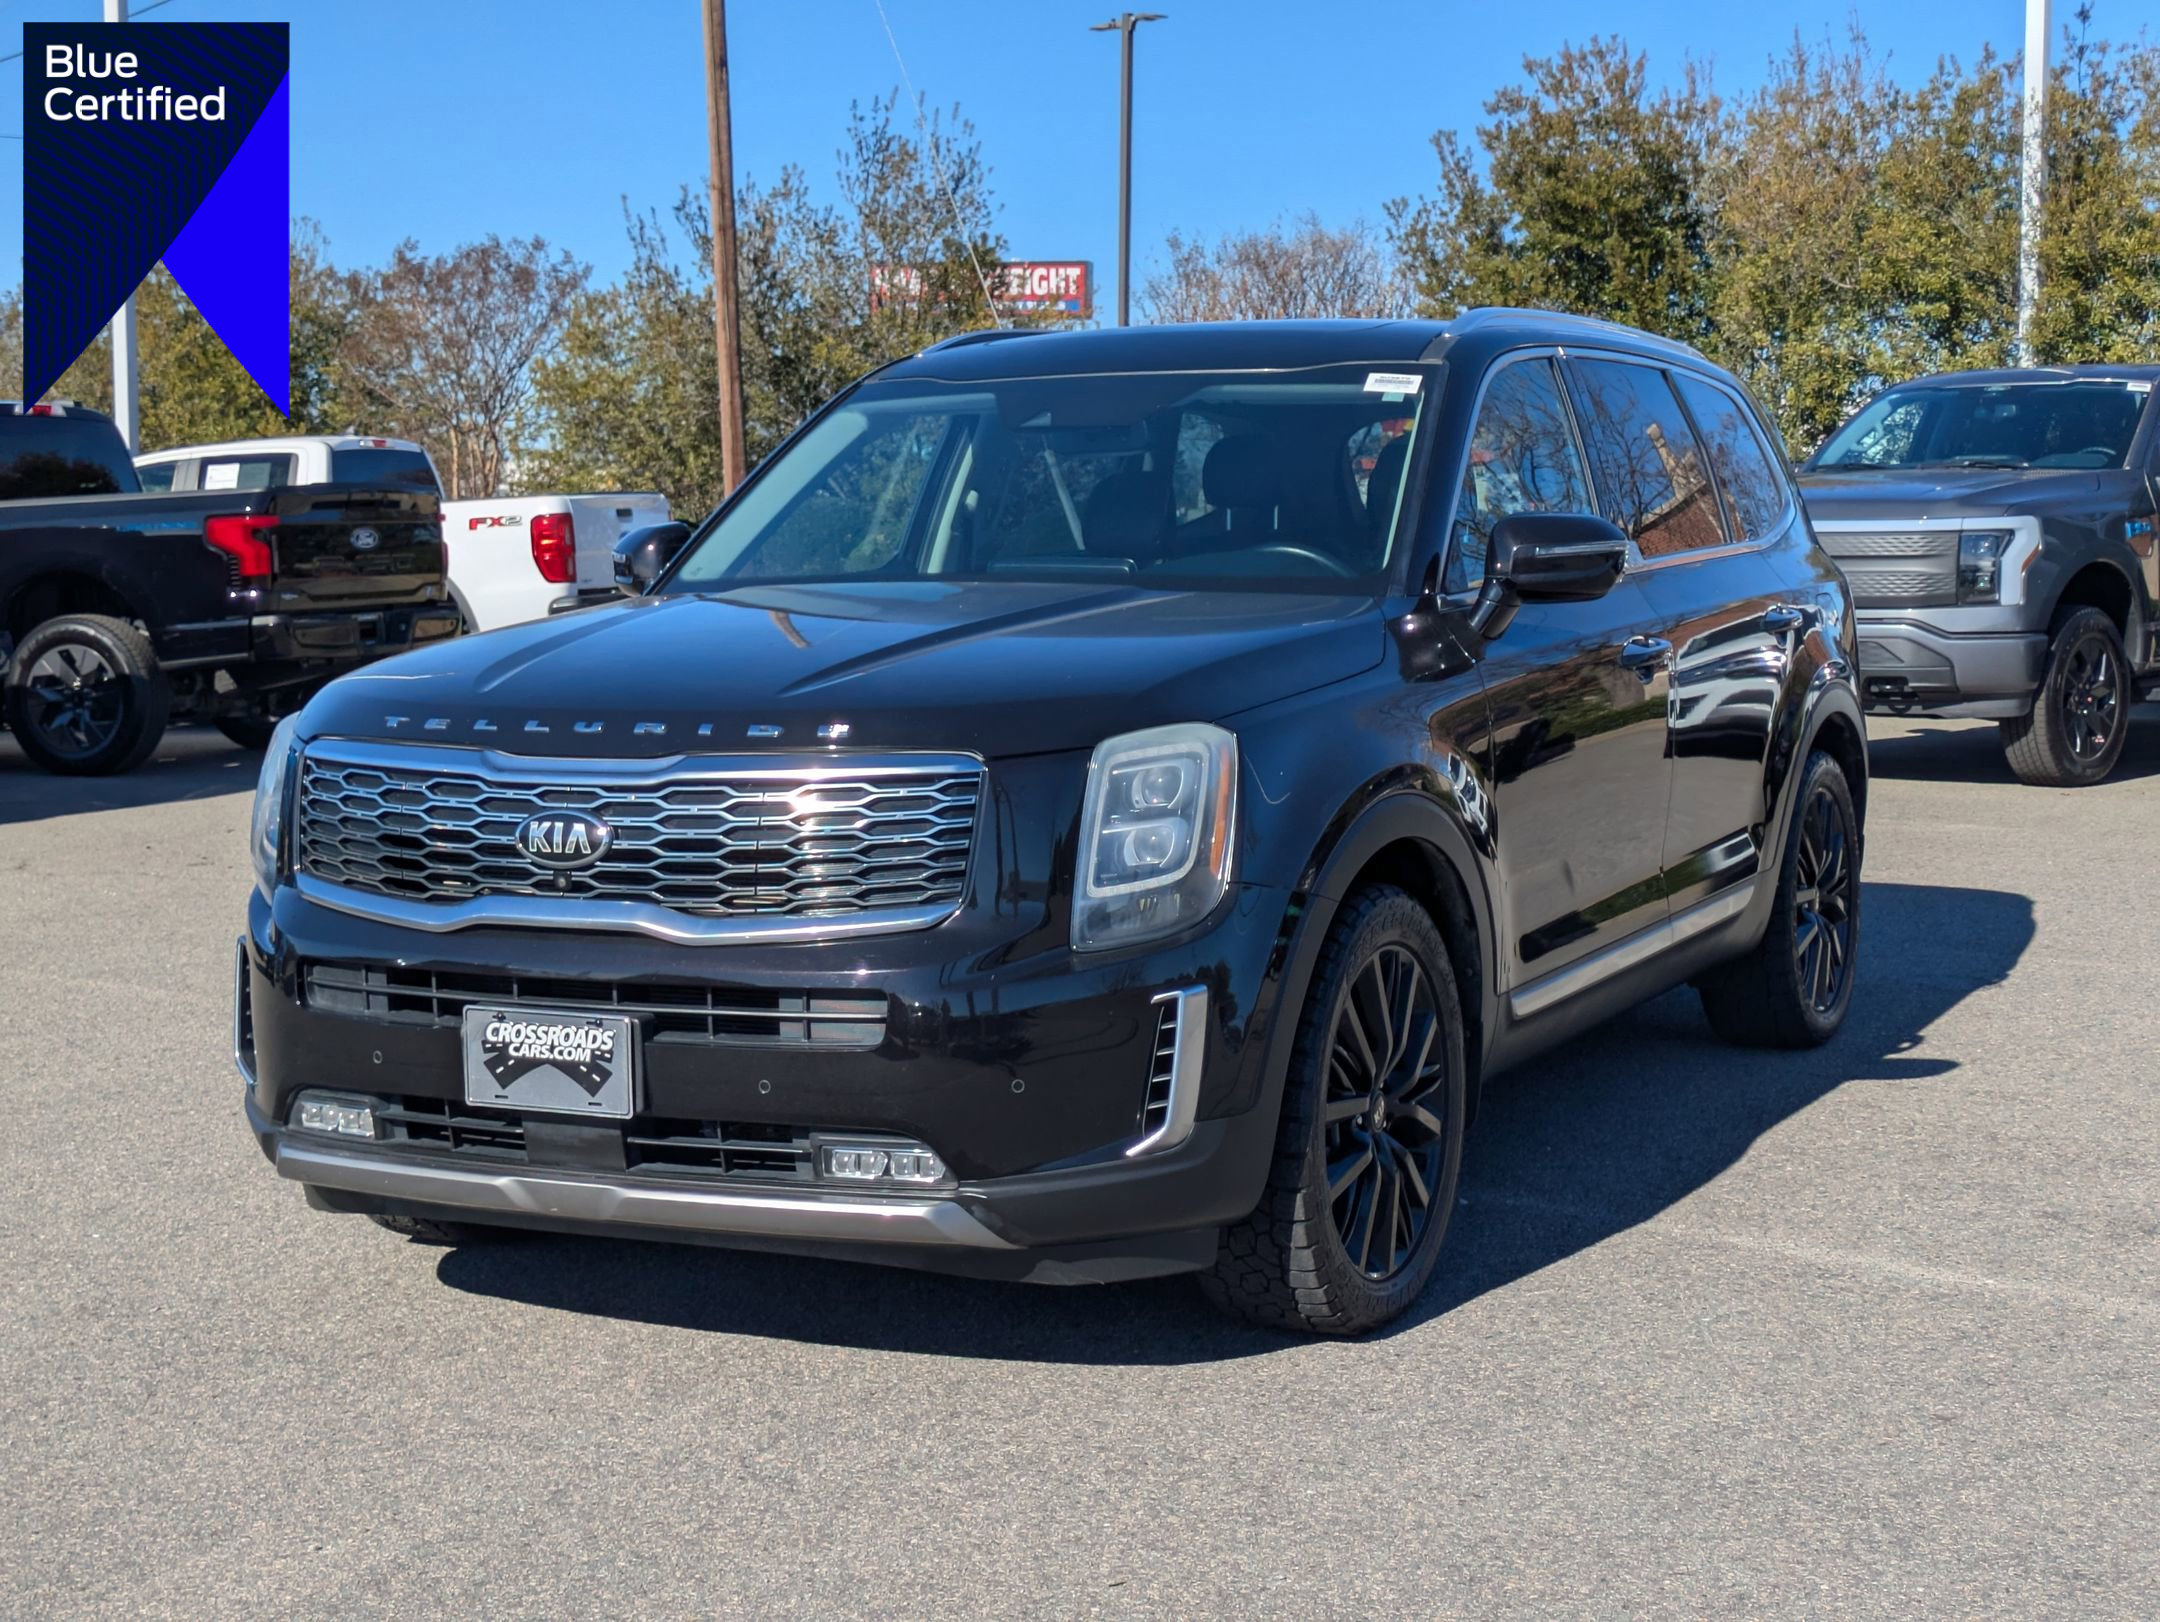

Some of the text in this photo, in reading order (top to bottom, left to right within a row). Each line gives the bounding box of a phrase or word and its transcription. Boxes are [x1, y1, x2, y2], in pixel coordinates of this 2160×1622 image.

[469, 515, 522, 531] FX2
[384, 715, 850, 739] TELLURIDE
[528, 821, 592, 854] KIA
[486, 1020, 616, 1051] CROSSROADS
[507, 1042, 593, 1063] CARS.COM
